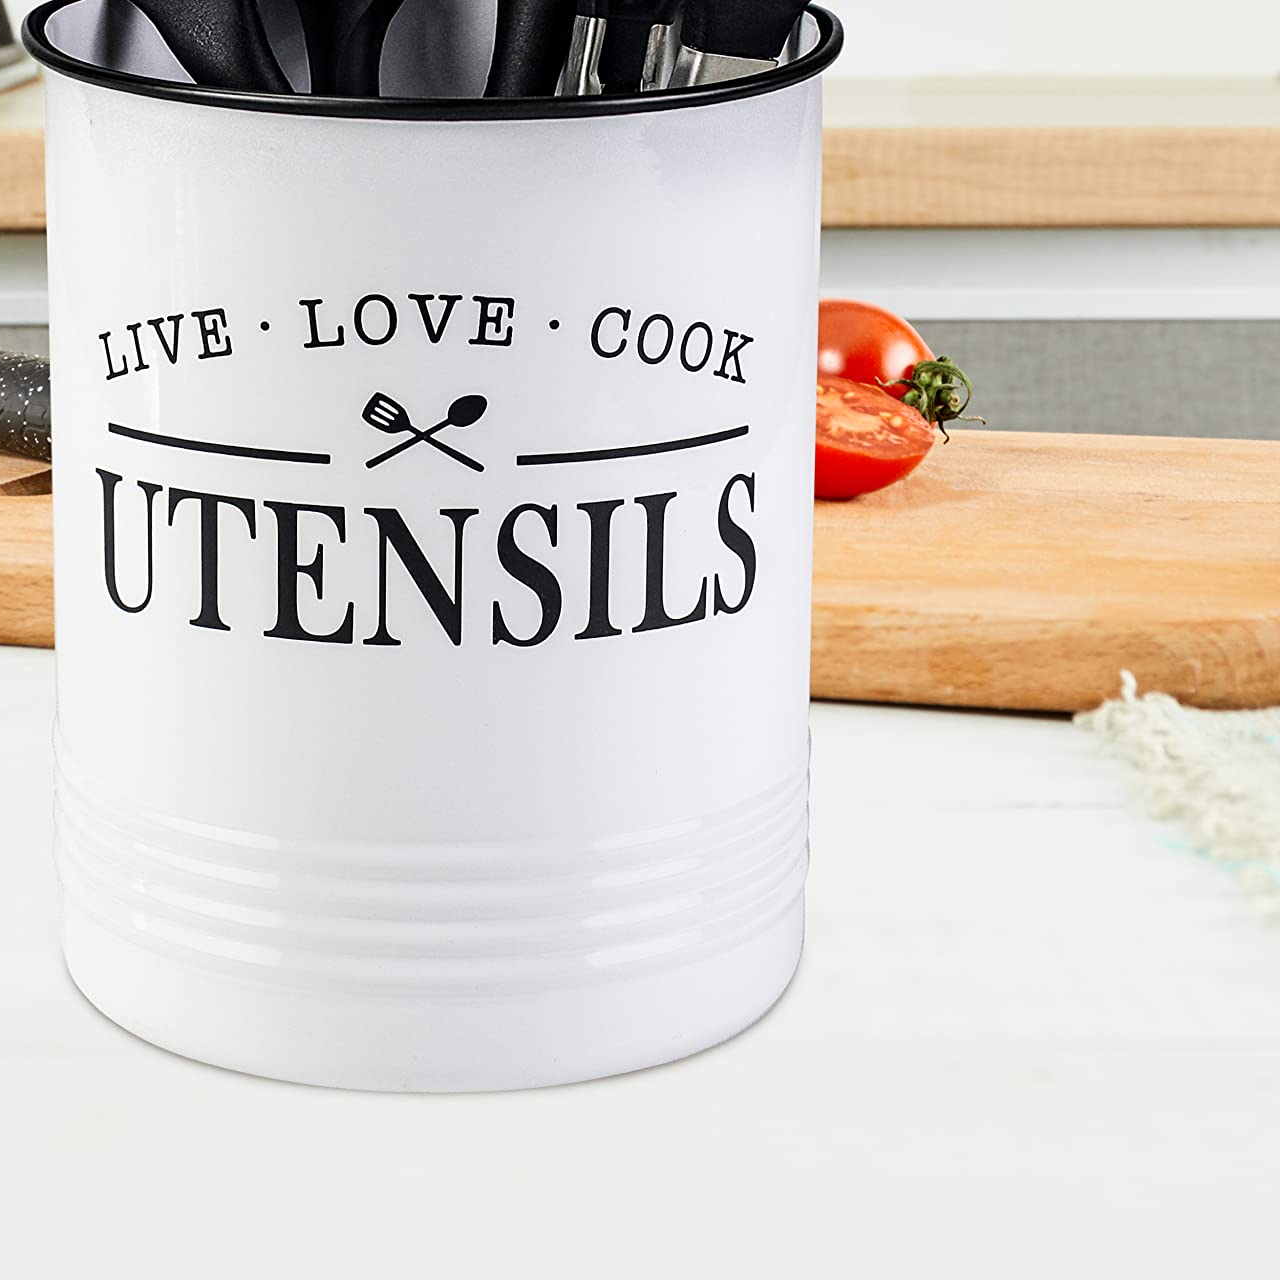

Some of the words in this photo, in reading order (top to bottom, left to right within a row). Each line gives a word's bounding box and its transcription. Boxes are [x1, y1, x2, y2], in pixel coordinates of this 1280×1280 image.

[98, 307, 233, 381] LIVE
[298, 293, 515, 349] LOVE
[590, 306, 755, 385] COOK
[95, 467, 757, 648] UTENSILS
